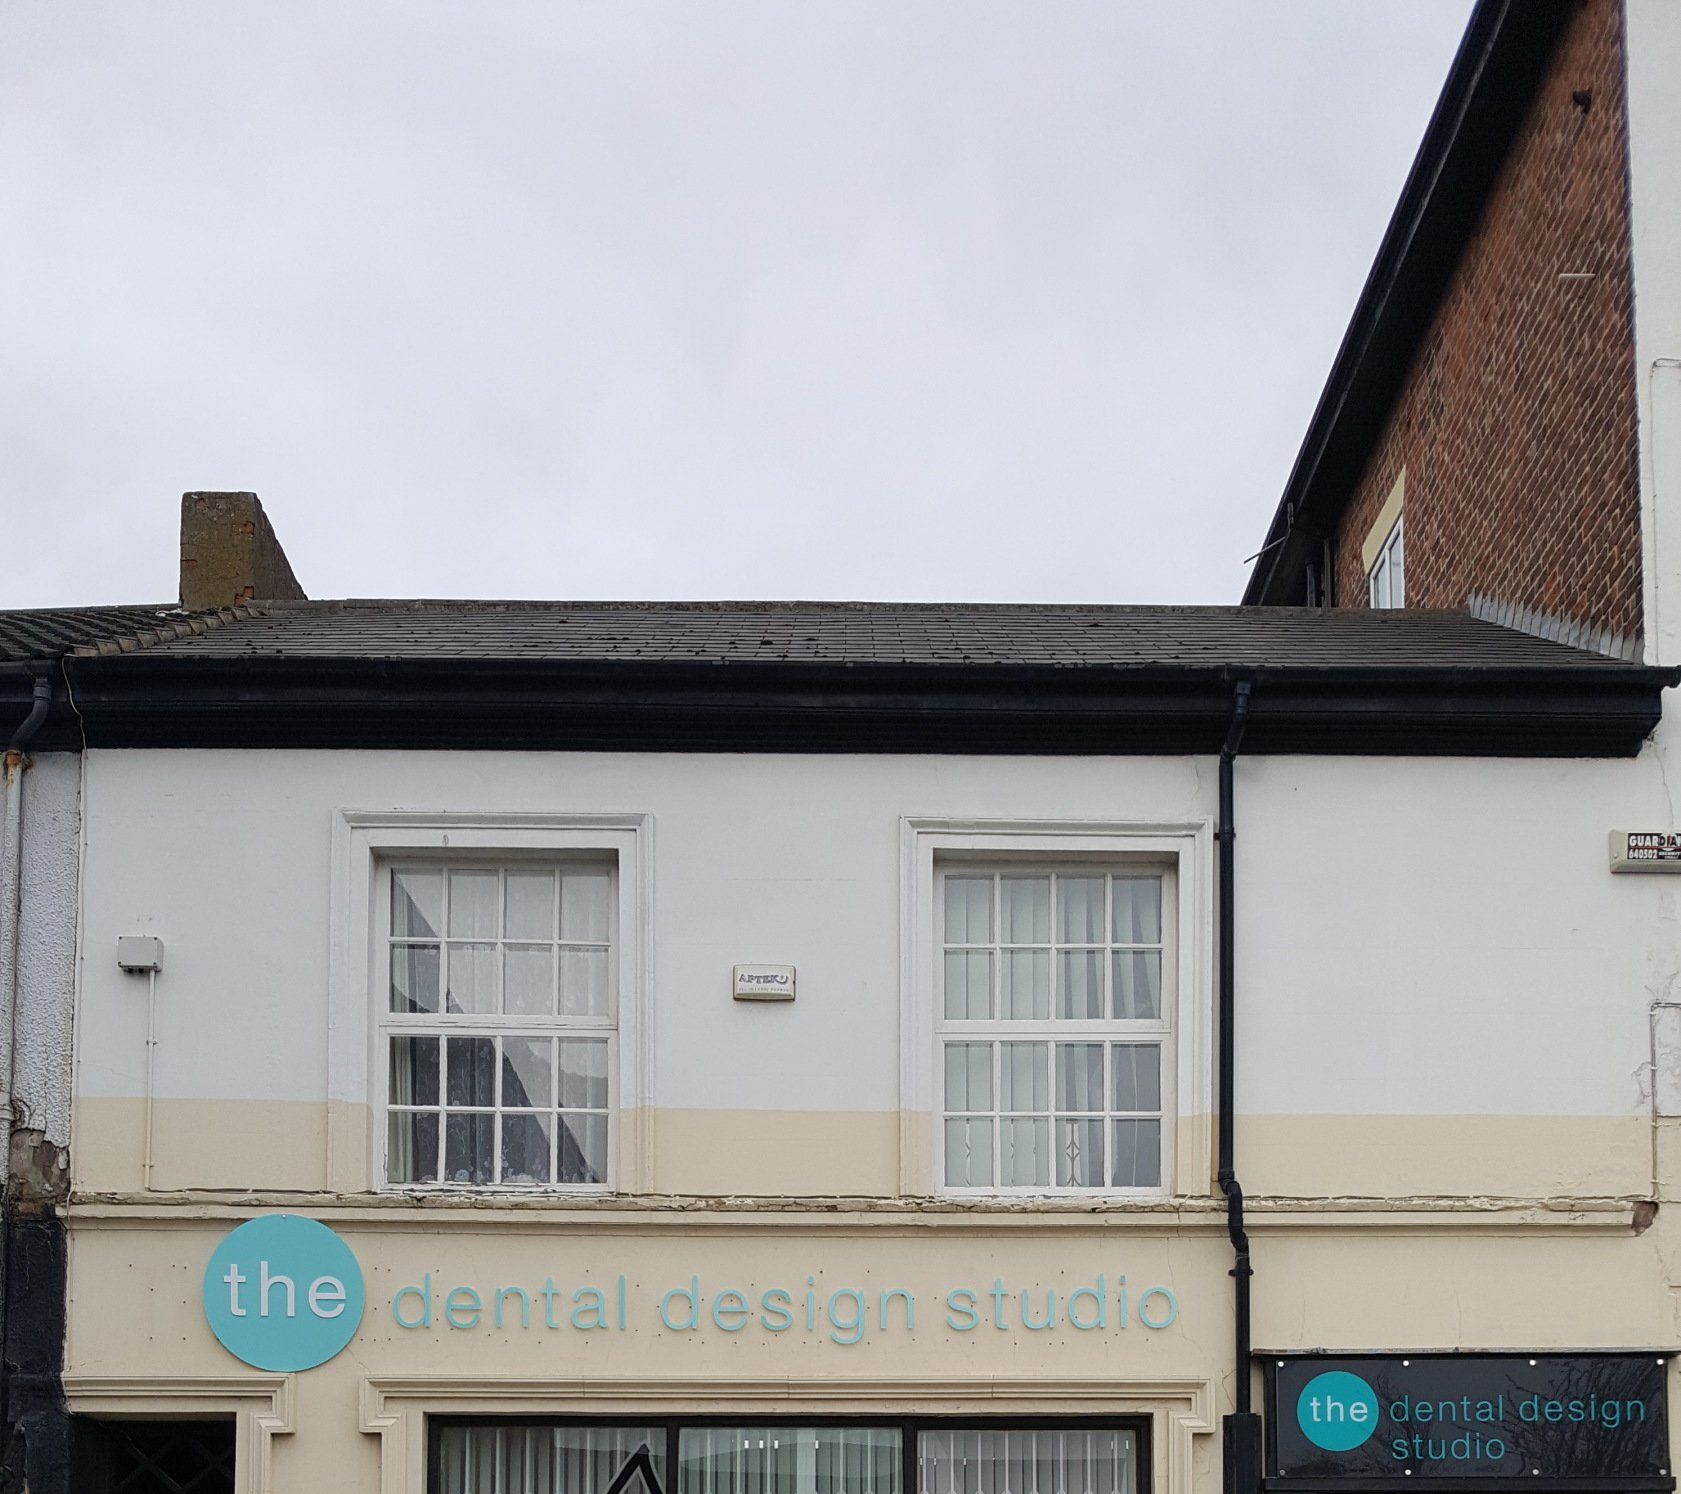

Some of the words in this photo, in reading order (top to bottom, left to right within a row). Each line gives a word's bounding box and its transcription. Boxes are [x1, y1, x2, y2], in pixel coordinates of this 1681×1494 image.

[1628, 849, 1658, 859] 640502
[224, 1261, 347, 1320] the
[393, 1273, 627, 1330] dental
[660, 1275, 914, 1344] design
[946, 1274, 1179, 1330] studio
[1310, 1396, 1369, 1422] the
[1389, 1395, 1505, 1422] dental
[1518, 1393, 1646, 1428] design
[1392, 1432, 1506, 1460] studio
